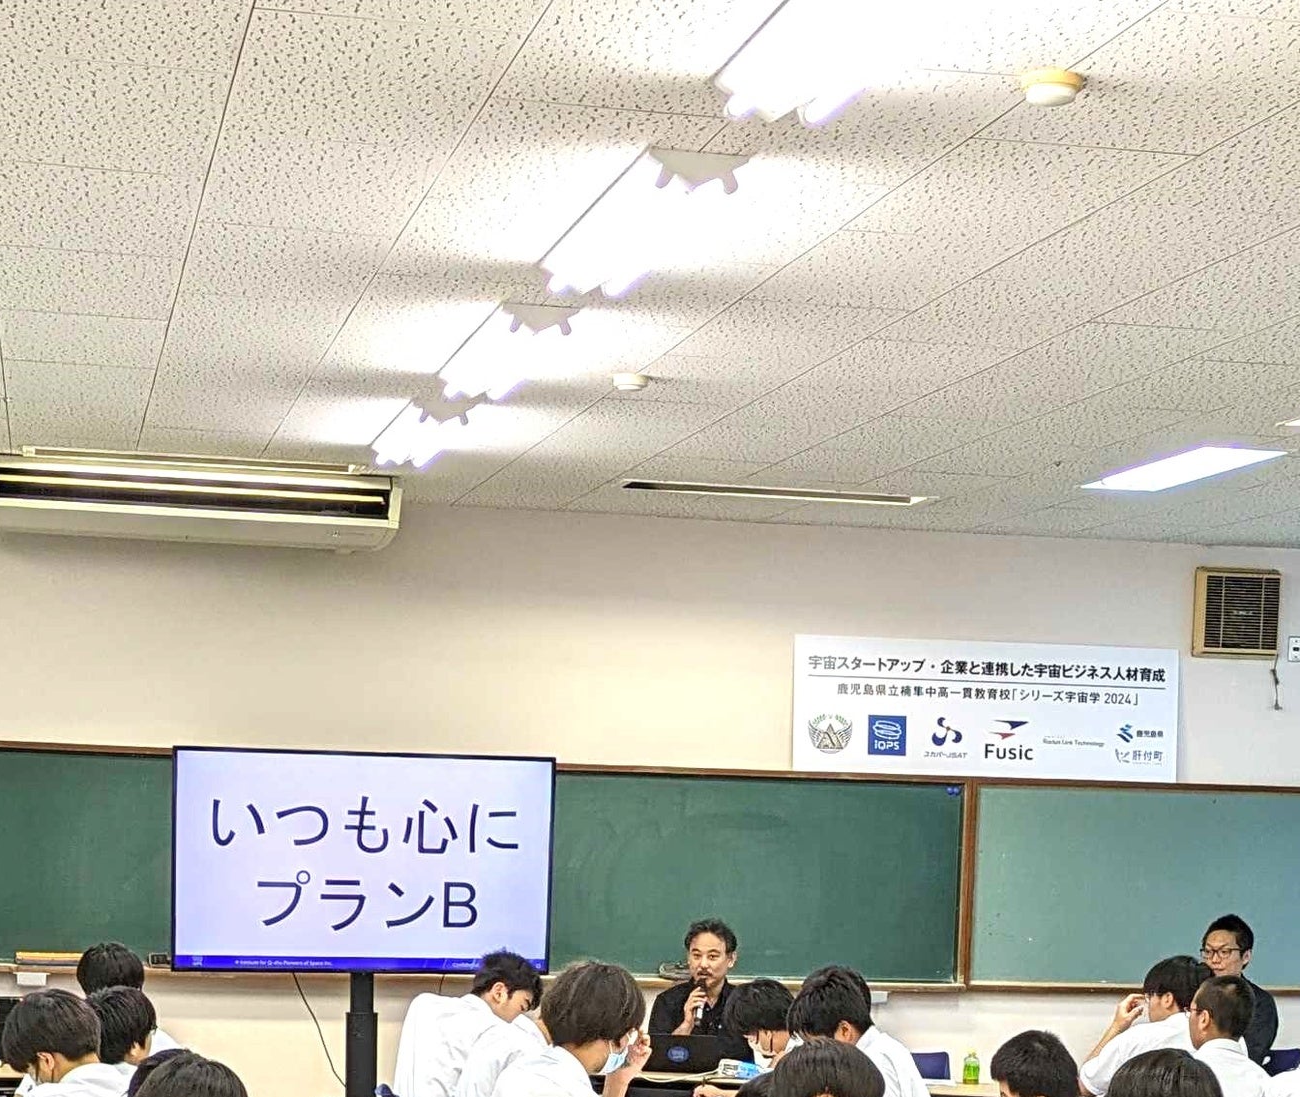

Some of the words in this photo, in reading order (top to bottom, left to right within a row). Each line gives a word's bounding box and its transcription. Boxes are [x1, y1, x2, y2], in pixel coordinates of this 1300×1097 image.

[808, 655, 1166, 683] 宇宙スタートアップ・企業と連携した宇宙ビジネス人材育成
[984, 743, 1034, 761] Fusic
[212, 796, 519, 855] いつも心に
[257, 870, 478, 932] プランB
